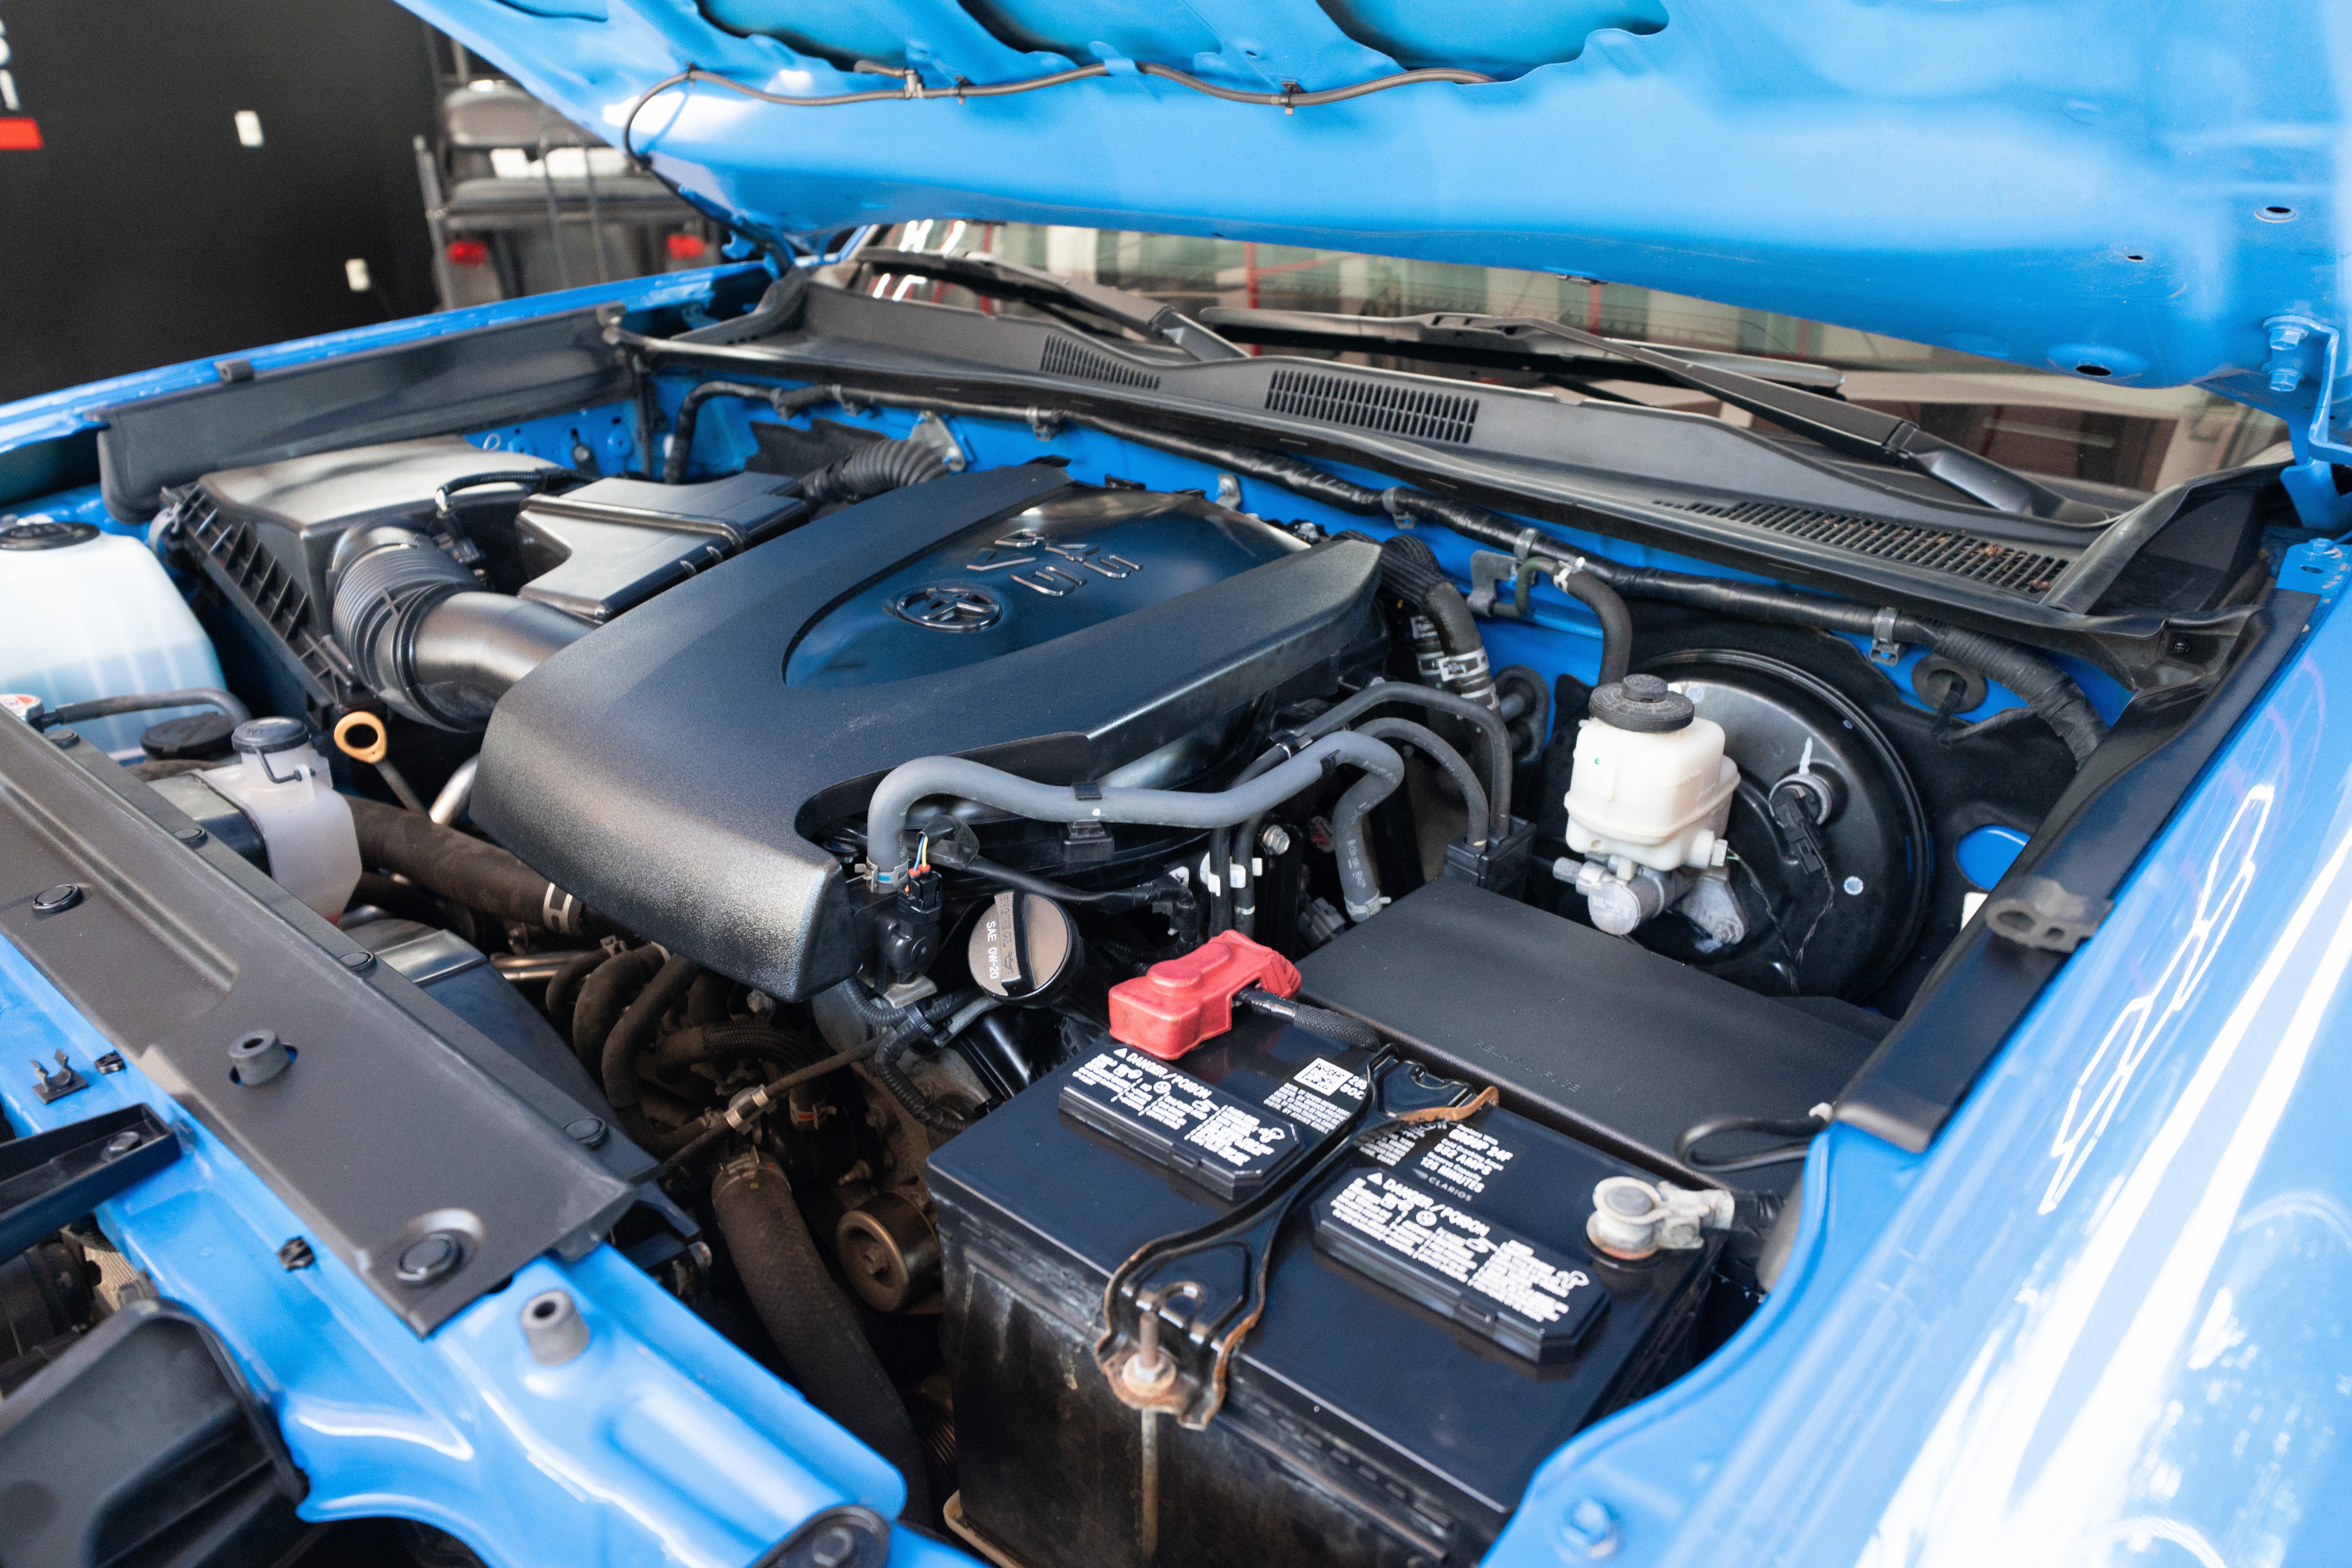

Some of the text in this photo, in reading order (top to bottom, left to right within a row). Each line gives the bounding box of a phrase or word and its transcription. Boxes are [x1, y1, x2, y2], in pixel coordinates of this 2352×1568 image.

[999, 895, 1012, 948] ENGINE OIL
[987, 920, 999, 980] SAE 0W-20
[1448, 1128, 1513, 1162] GROUP 24F
[1420, 1156, 1485, 1193] 125 MINUTES
[1456, 1154, 1493, 1176] AMPS
[1428, 1176, 1473, 1202] CLARIOS
